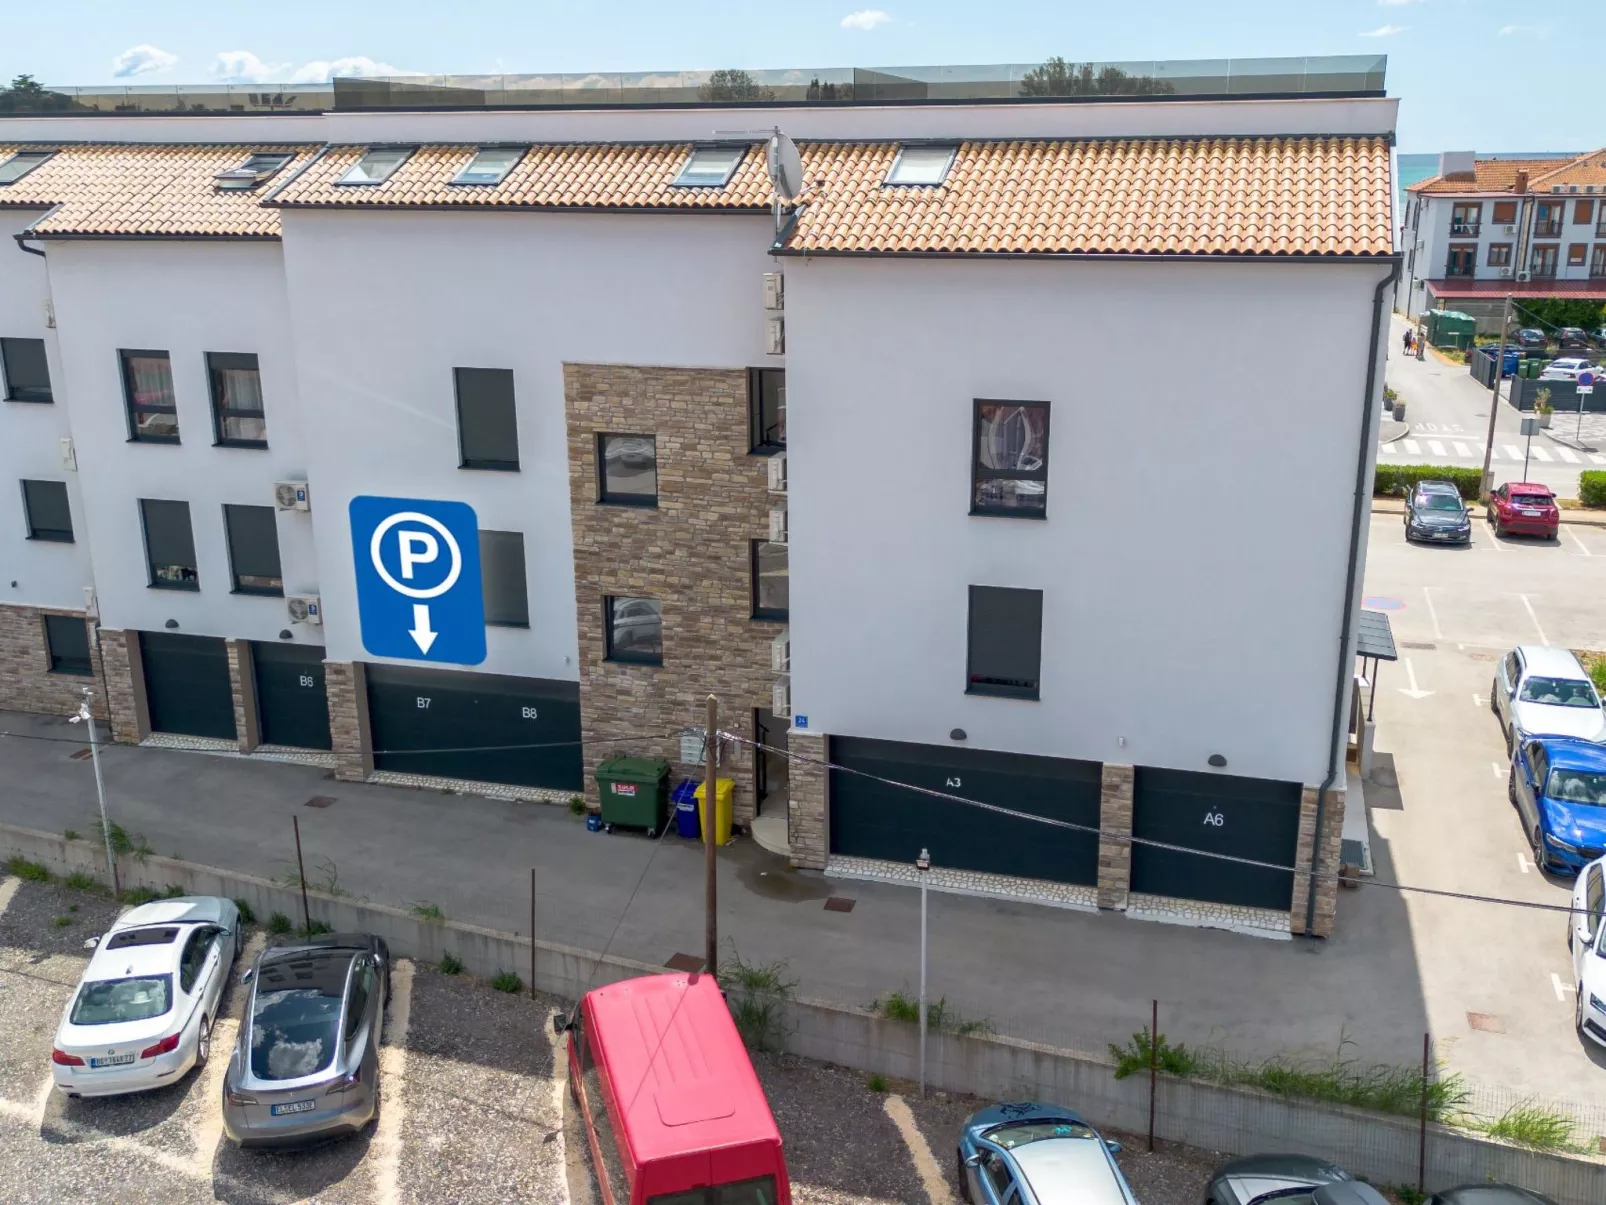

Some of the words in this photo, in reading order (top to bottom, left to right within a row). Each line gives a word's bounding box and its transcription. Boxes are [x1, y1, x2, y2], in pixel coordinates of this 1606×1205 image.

[398, 530, 439, 579] P
[299, 675, 314, 688] B6
[416, 696, 432, 709] B7
[521, 706, 538, 720] B8
[946, 778, 961, 788] A3
[1203, 812, 1224, 827] A6
